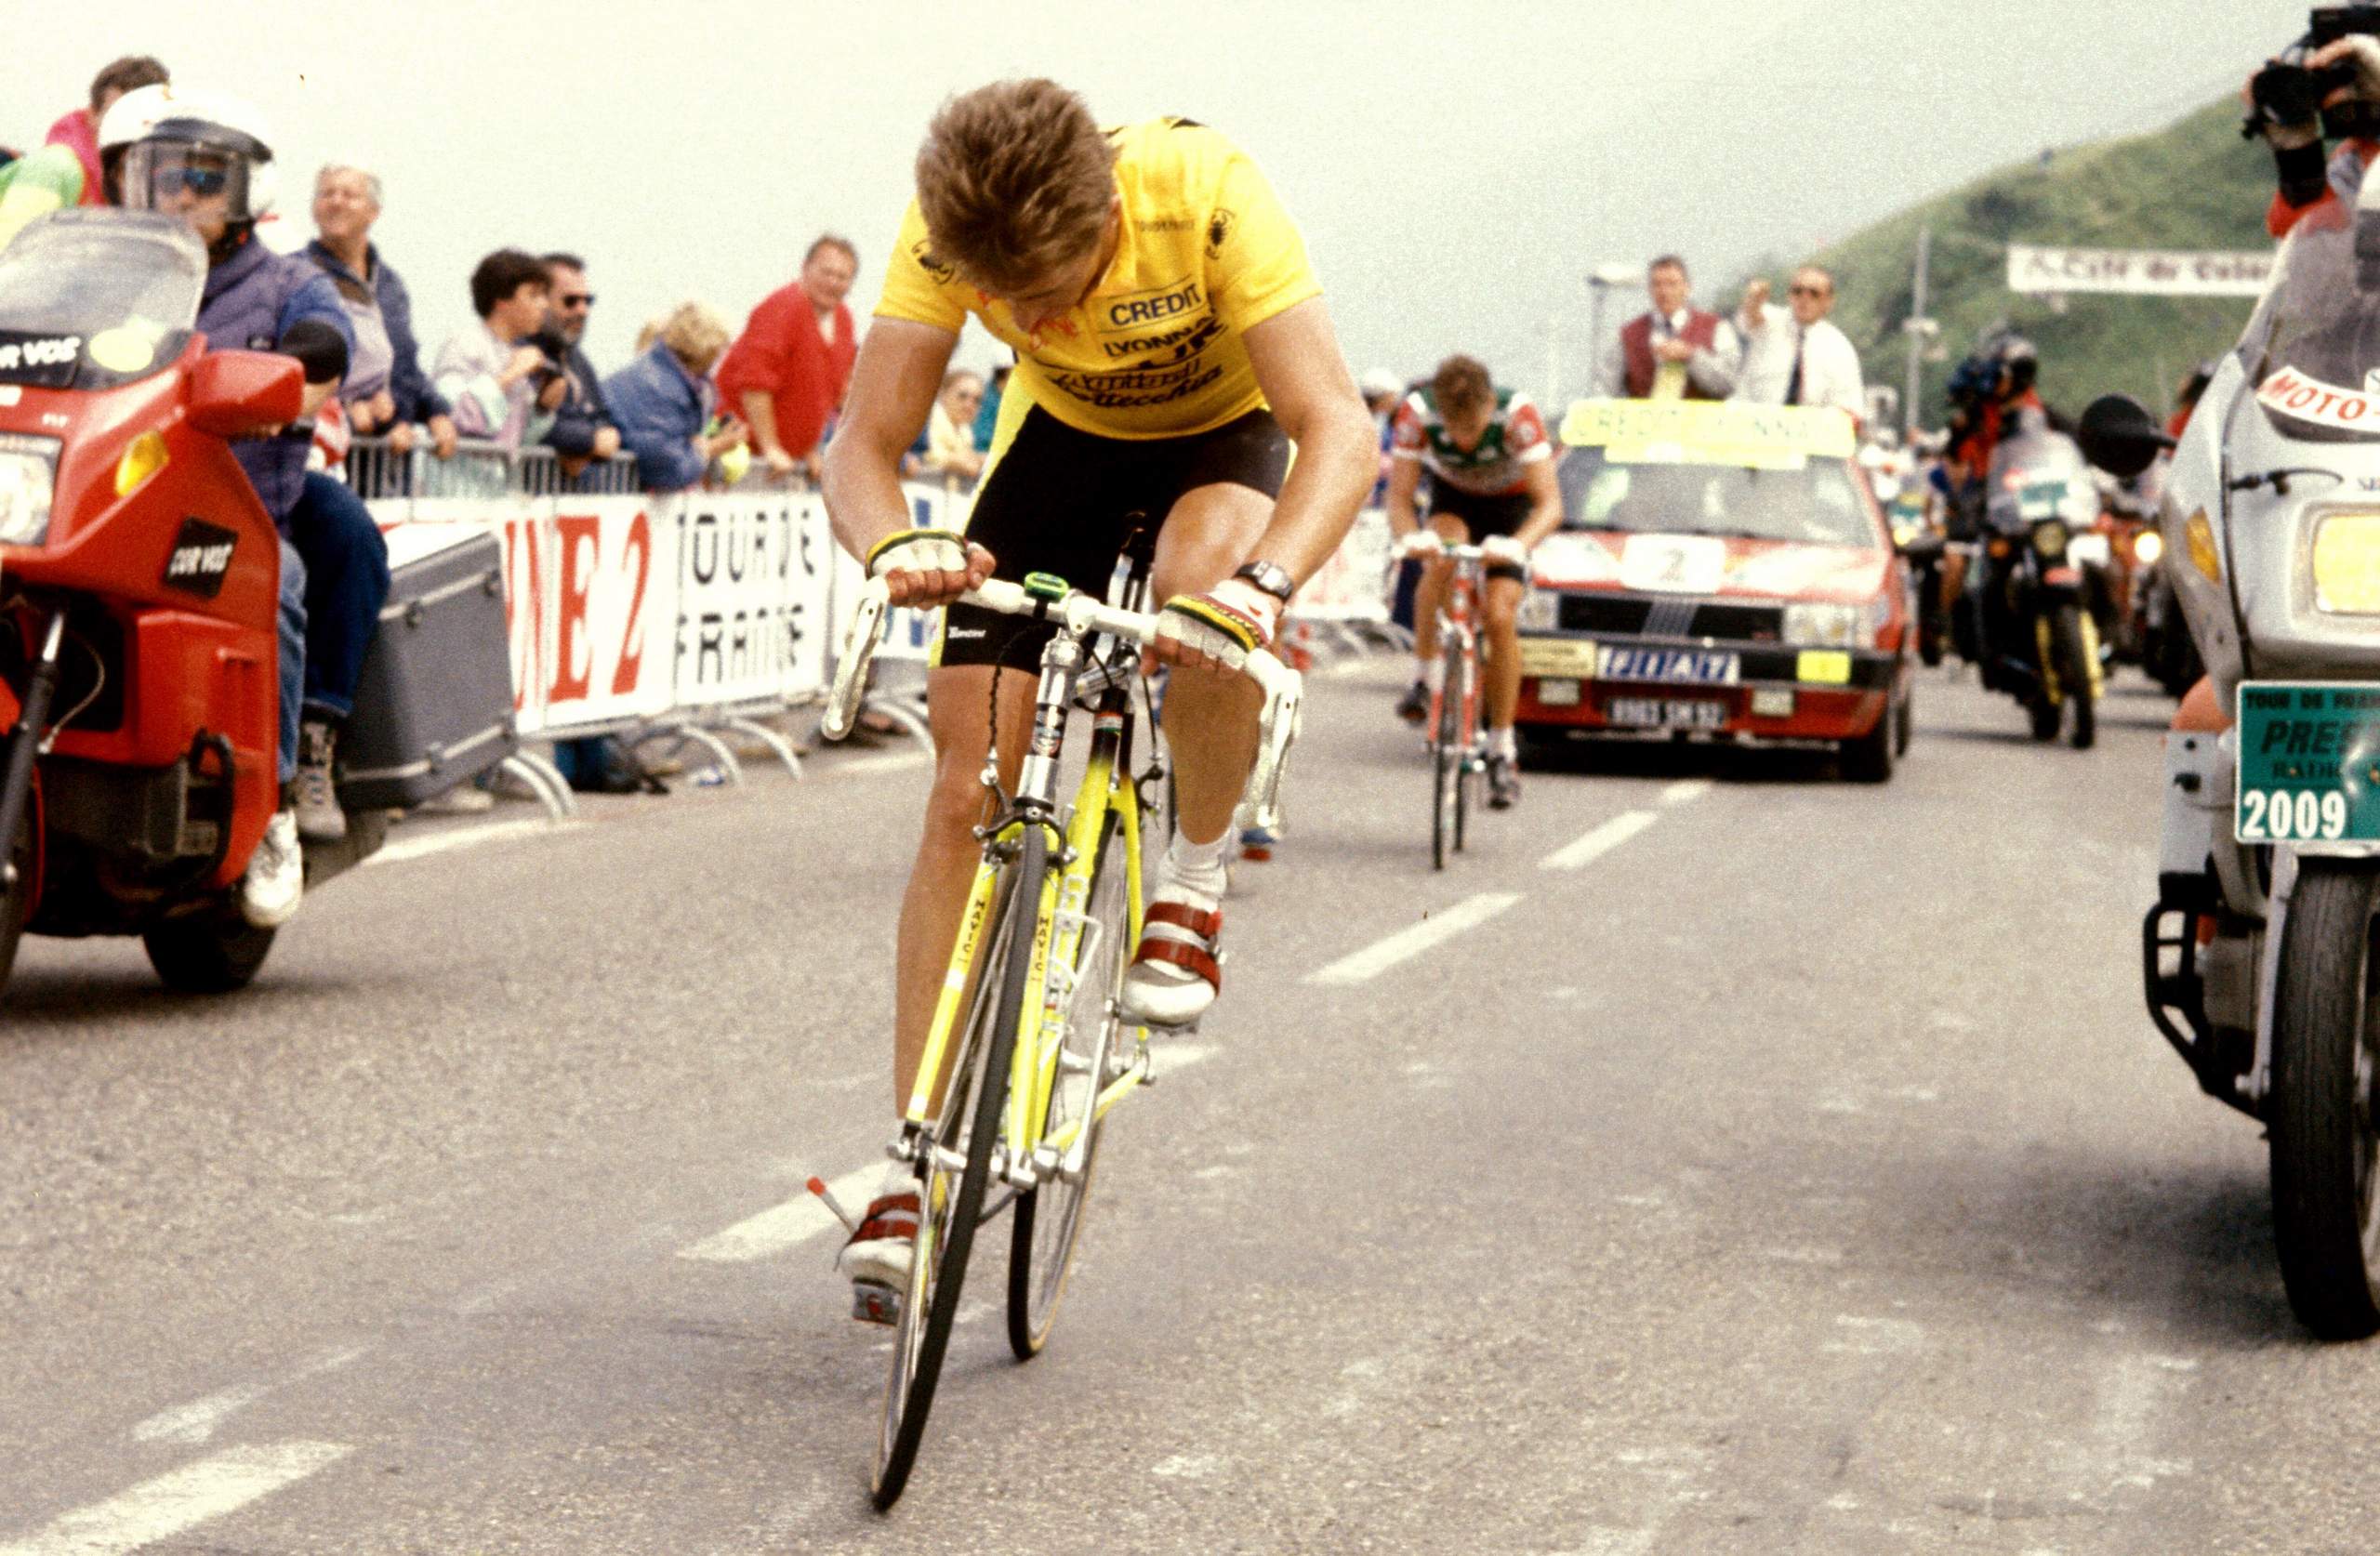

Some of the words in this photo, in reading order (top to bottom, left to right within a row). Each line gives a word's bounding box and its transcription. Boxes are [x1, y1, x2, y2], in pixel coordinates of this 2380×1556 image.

[1110, 284, 1201, 326] CREDIT
[610, 510, 650, 695] 2
[2246, 692, 2291, 709] TOUR
[2242, 790, 2346, 837] 2009
[963, 899, 985, 953] MAVIC
[1034, 916, 1050, 971] MAVIC
